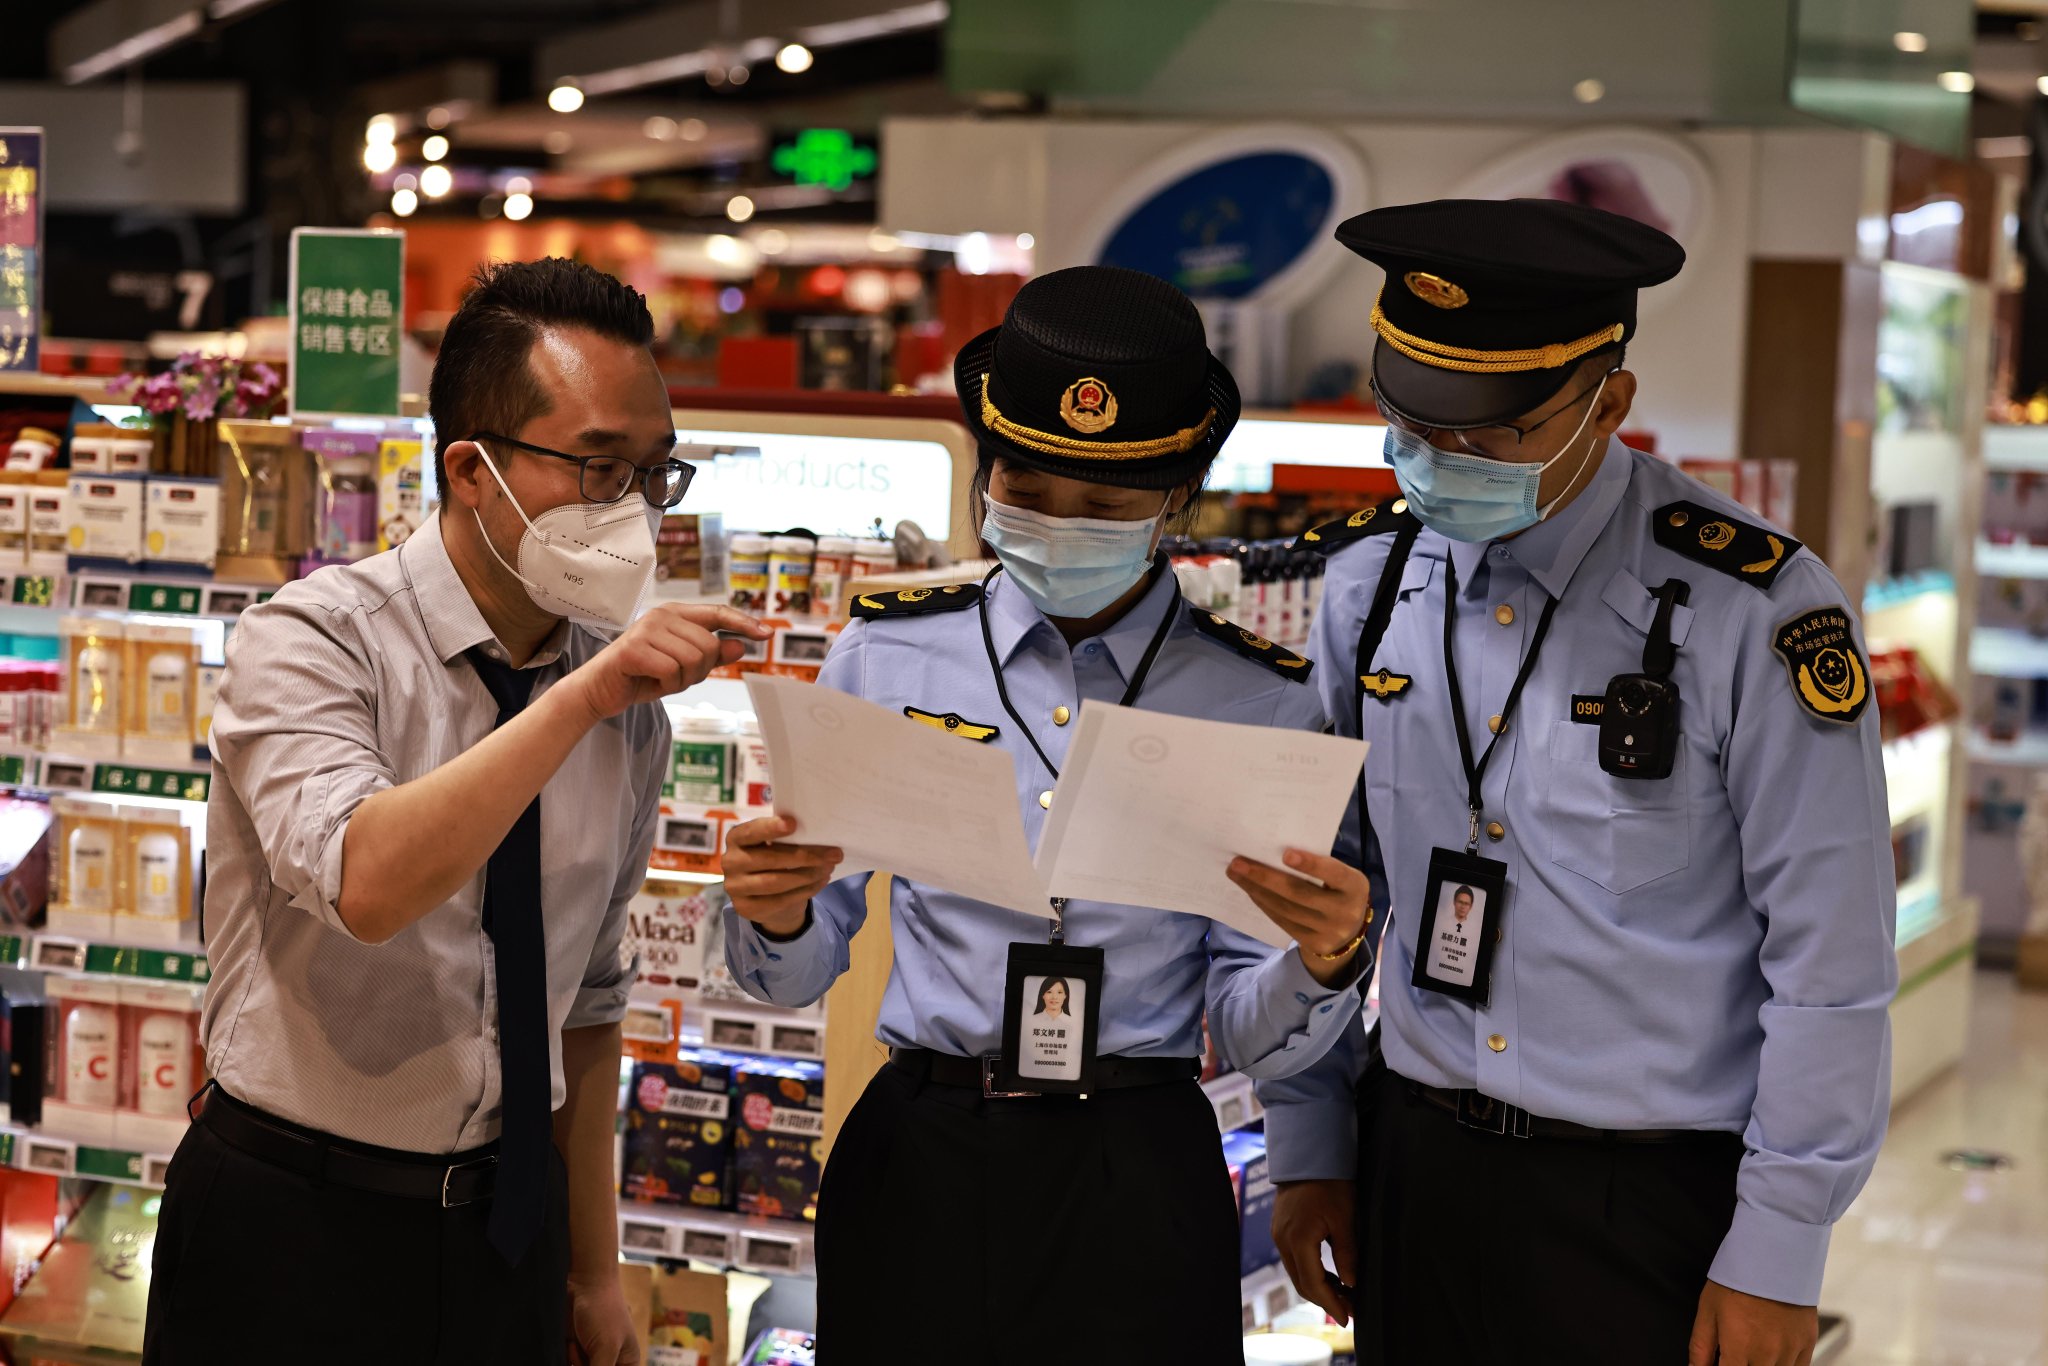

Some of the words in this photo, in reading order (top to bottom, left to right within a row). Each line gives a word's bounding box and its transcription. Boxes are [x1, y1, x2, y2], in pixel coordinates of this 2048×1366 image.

[301, 286, 392, 318] 保健食品
[301, 323, 391, 356] 销售专区
[563, 572, 584, 586] N95
[1783, 615, 1845, 647] 中华人民共和国
[1795, 630, 1845, 653] 市场监管执法
[627, 913, 695, 945] Maca
[88, 1056, 107, 1080] C
[156, 1064, 176, 1089] C
